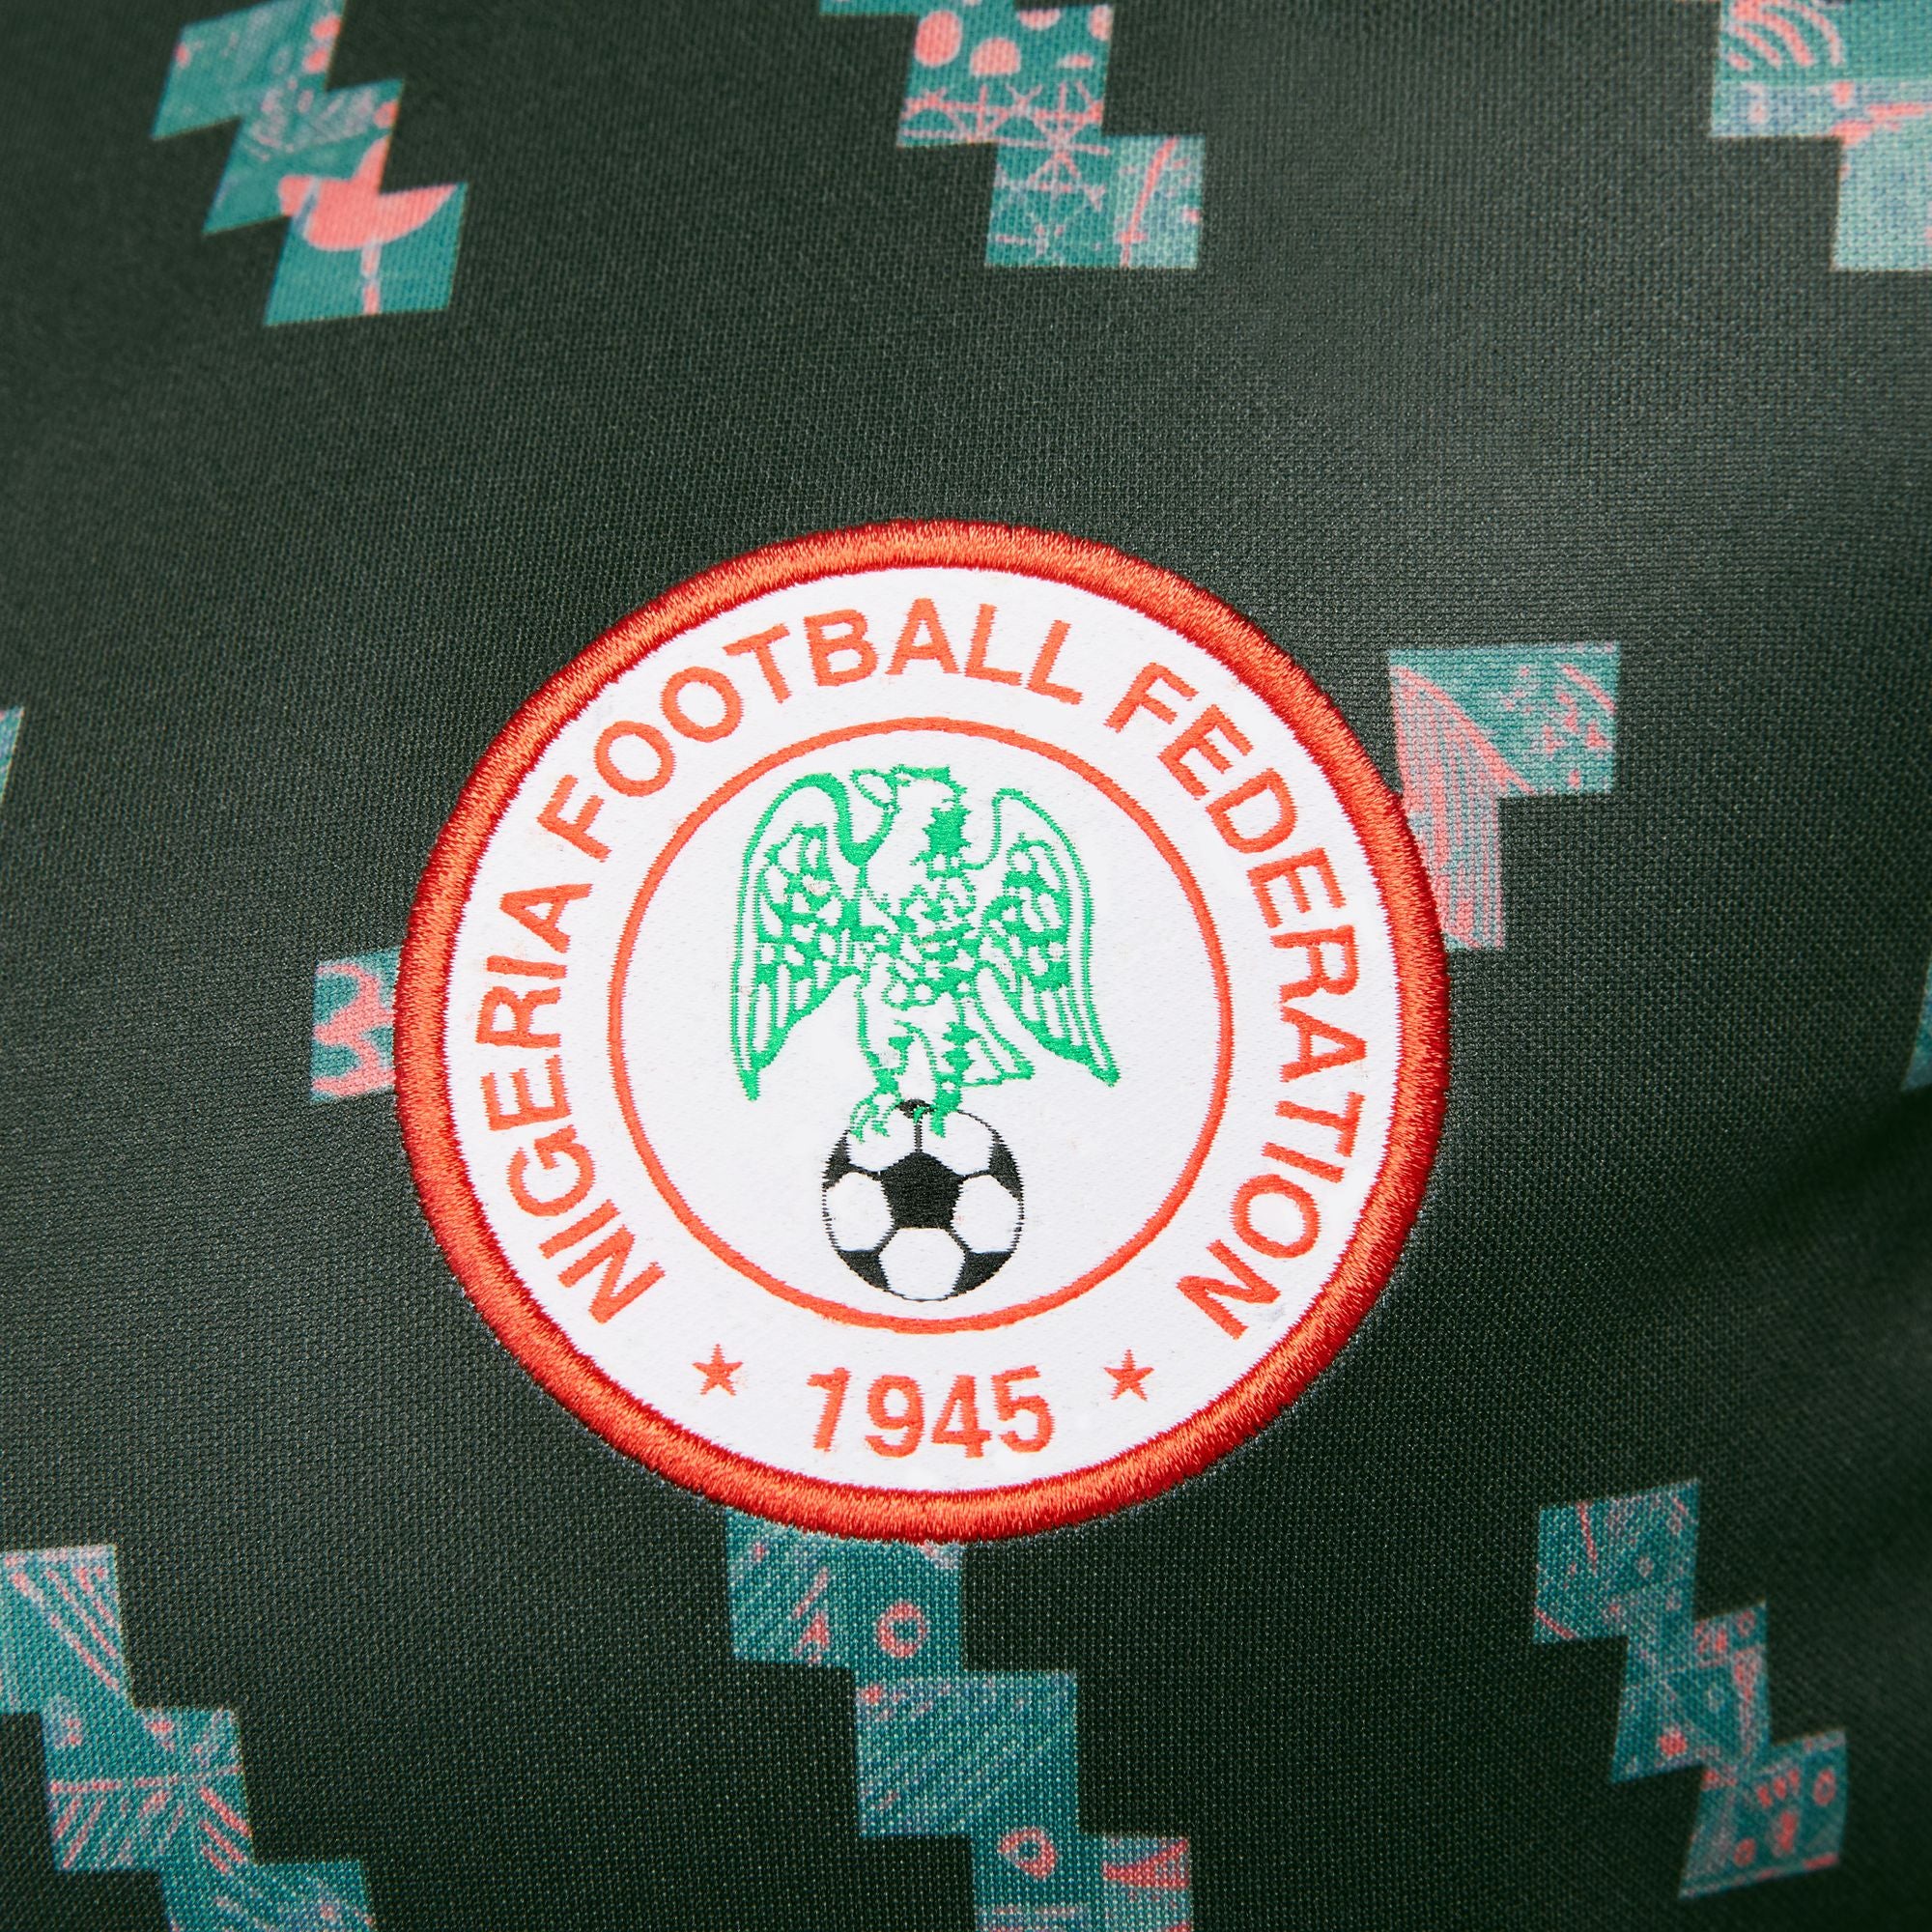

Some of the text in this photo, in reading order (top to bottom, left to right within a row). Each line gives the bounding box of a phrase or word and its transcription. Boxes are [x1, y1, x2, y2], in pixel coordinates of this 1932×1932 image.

[474, 598, 1367, 1341] NIGERIA FOOTBALL FEDERATION
[807, 1365, 1055, 1459] 1945
